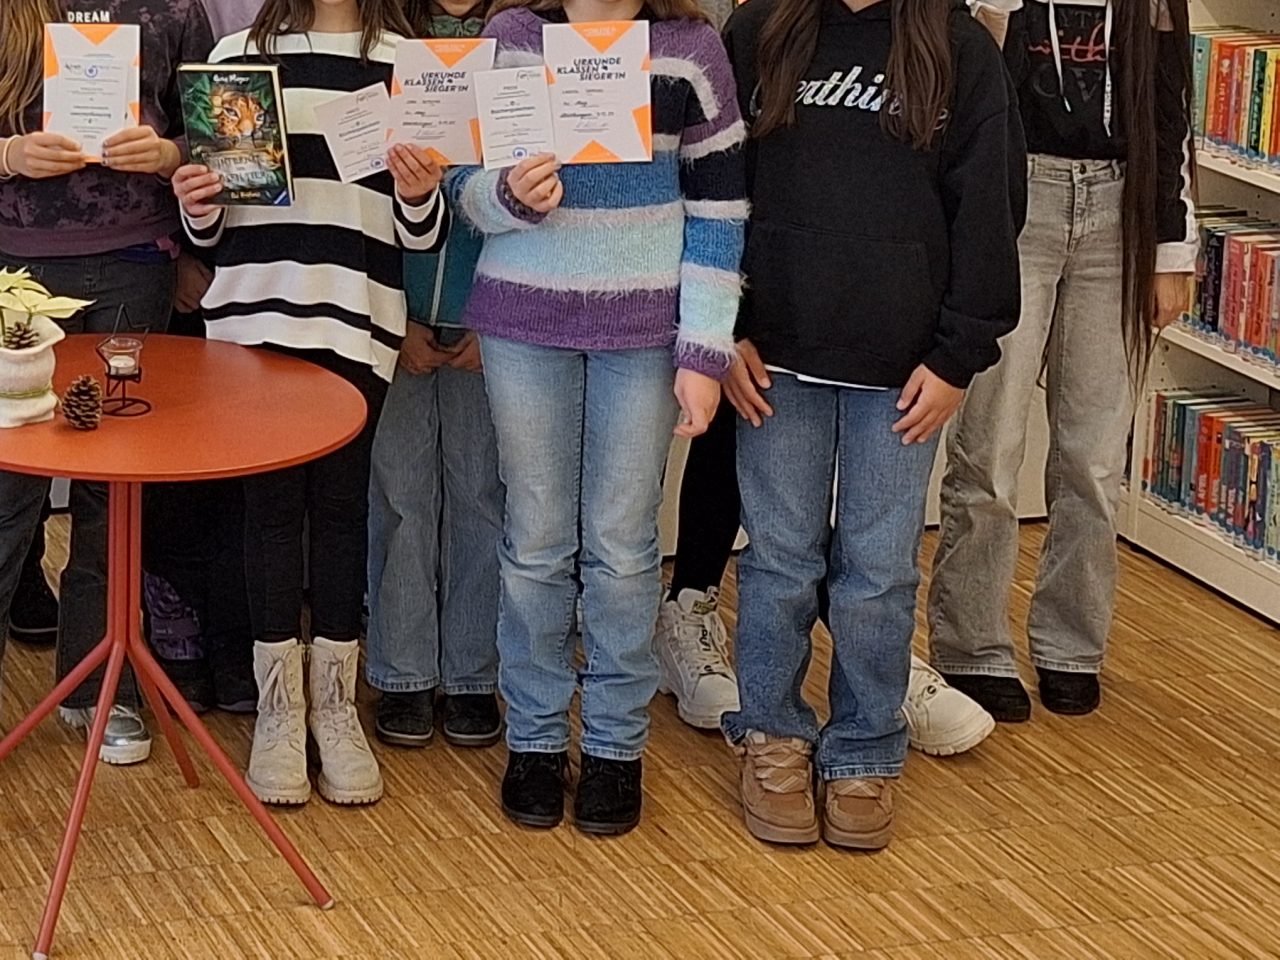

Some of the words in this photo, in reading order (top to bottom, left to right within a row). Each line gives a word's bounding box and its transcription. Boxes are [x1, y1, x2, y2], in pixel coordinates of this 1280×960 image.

[67, 10, 111, 23] DREAM
[573, 57, 622, 67] URKUNDE
[557, 65, 600, 75] KLASSEN
[421, 71, 467, 80] URKUNDE
[404, 78, 445, 87] KLASSEN
